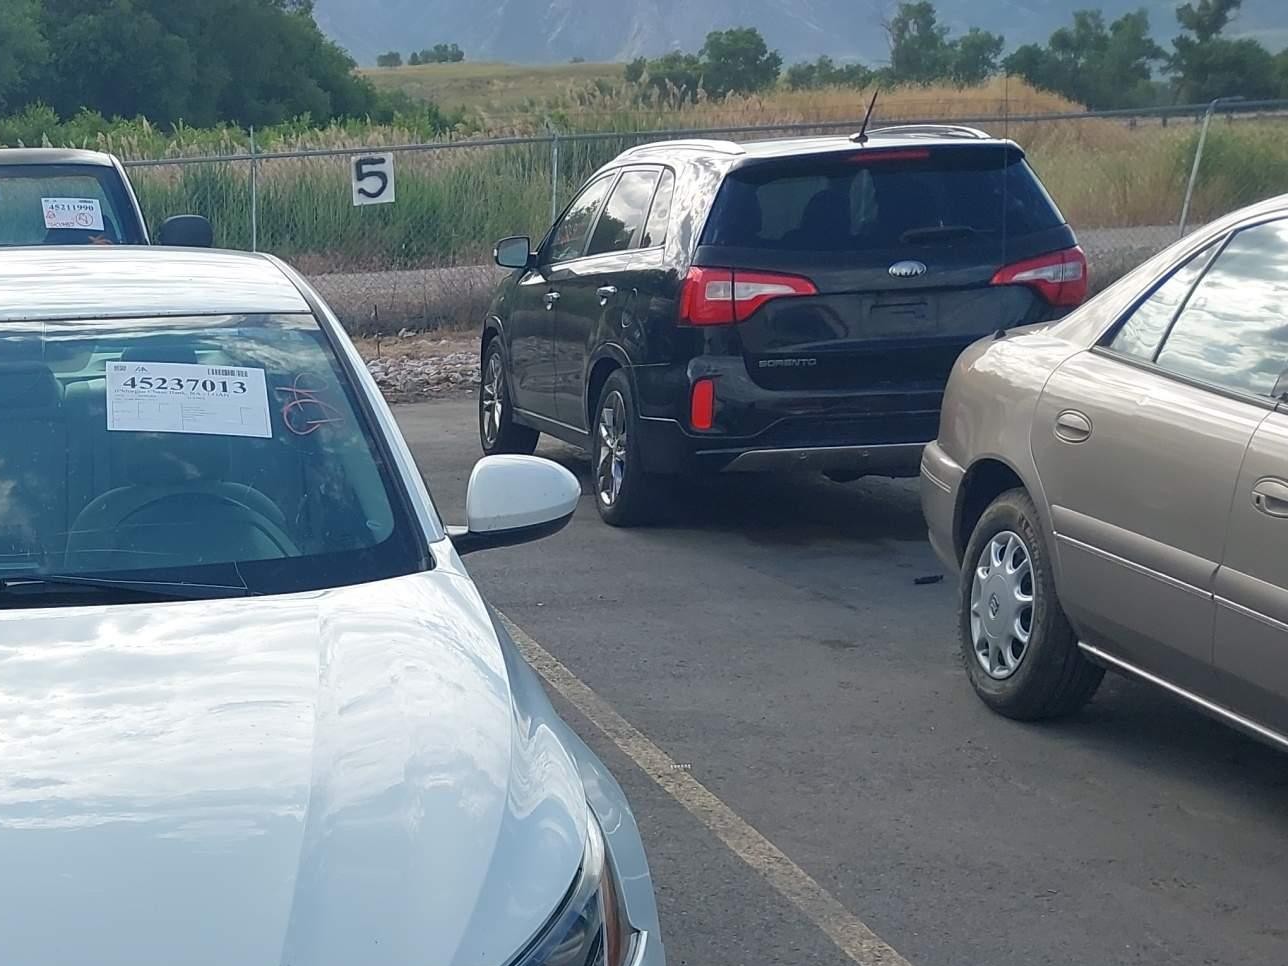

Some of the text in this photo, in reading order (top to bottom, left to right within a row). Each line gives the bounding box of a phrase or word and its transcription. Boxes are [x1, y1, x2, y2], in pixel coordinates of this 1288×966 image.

[355, 157, 389, 198] 5
[759, 359, 817, 368] SORENTO
[123, 376, 247, 394] 45237013
